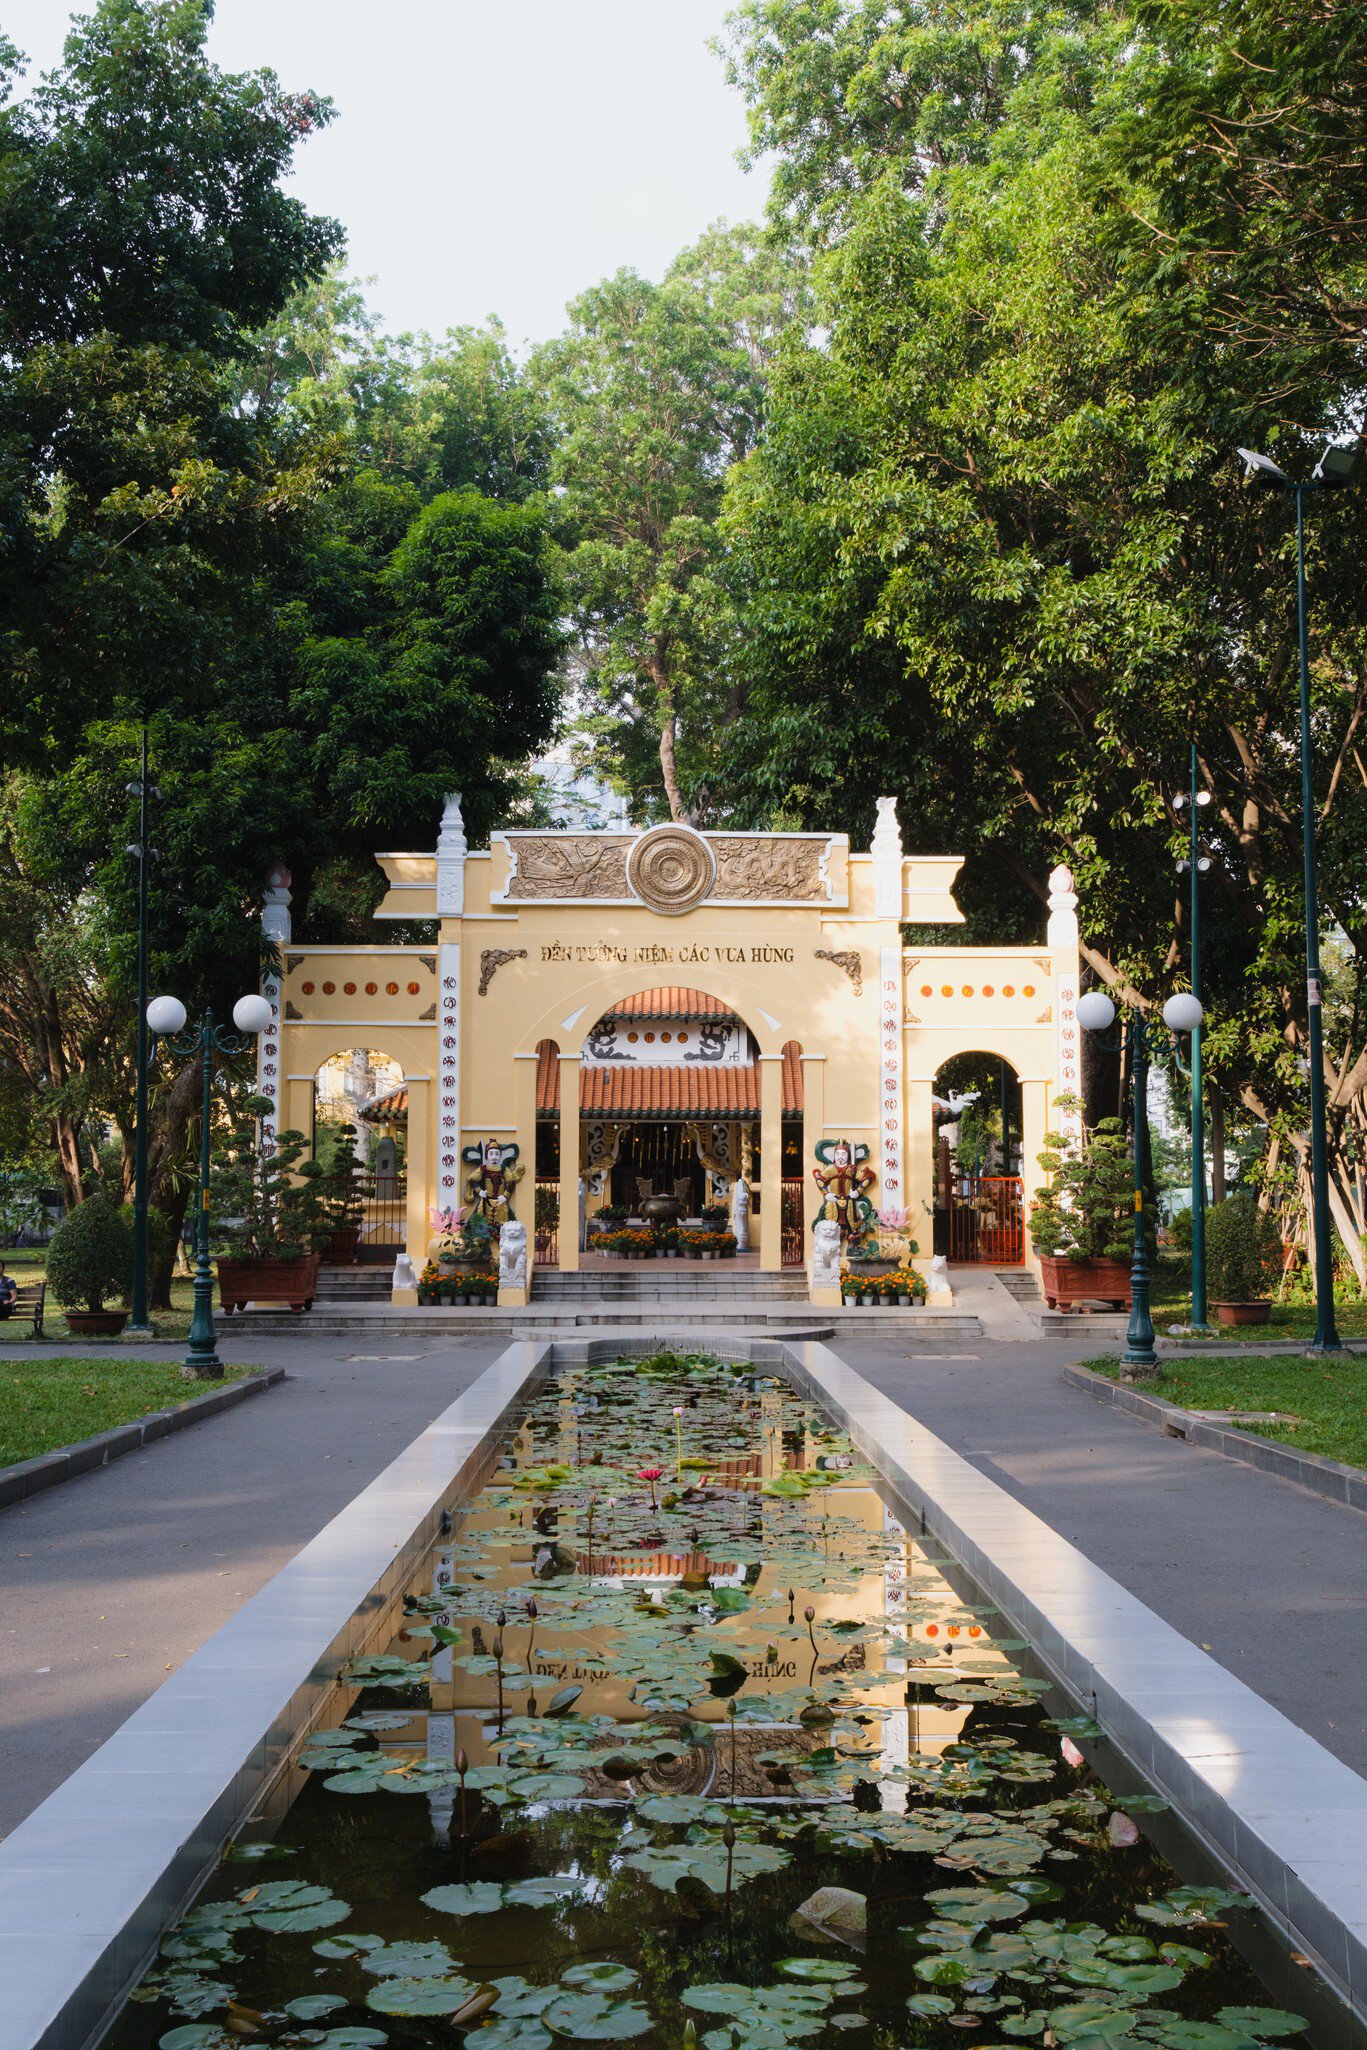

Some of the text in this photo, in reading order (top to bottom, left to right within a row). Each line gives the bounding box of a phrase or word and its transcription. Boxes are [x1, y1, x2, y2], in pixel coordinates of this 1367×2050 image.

[541, 940, 572, 962] ĐỀN
[634, 944, 673, 965] NIỆM
[679, 943, 709, 962] CÁC
[715, 947, 746, 962] VUA
[751, 943, 794, 963] HÙNG
